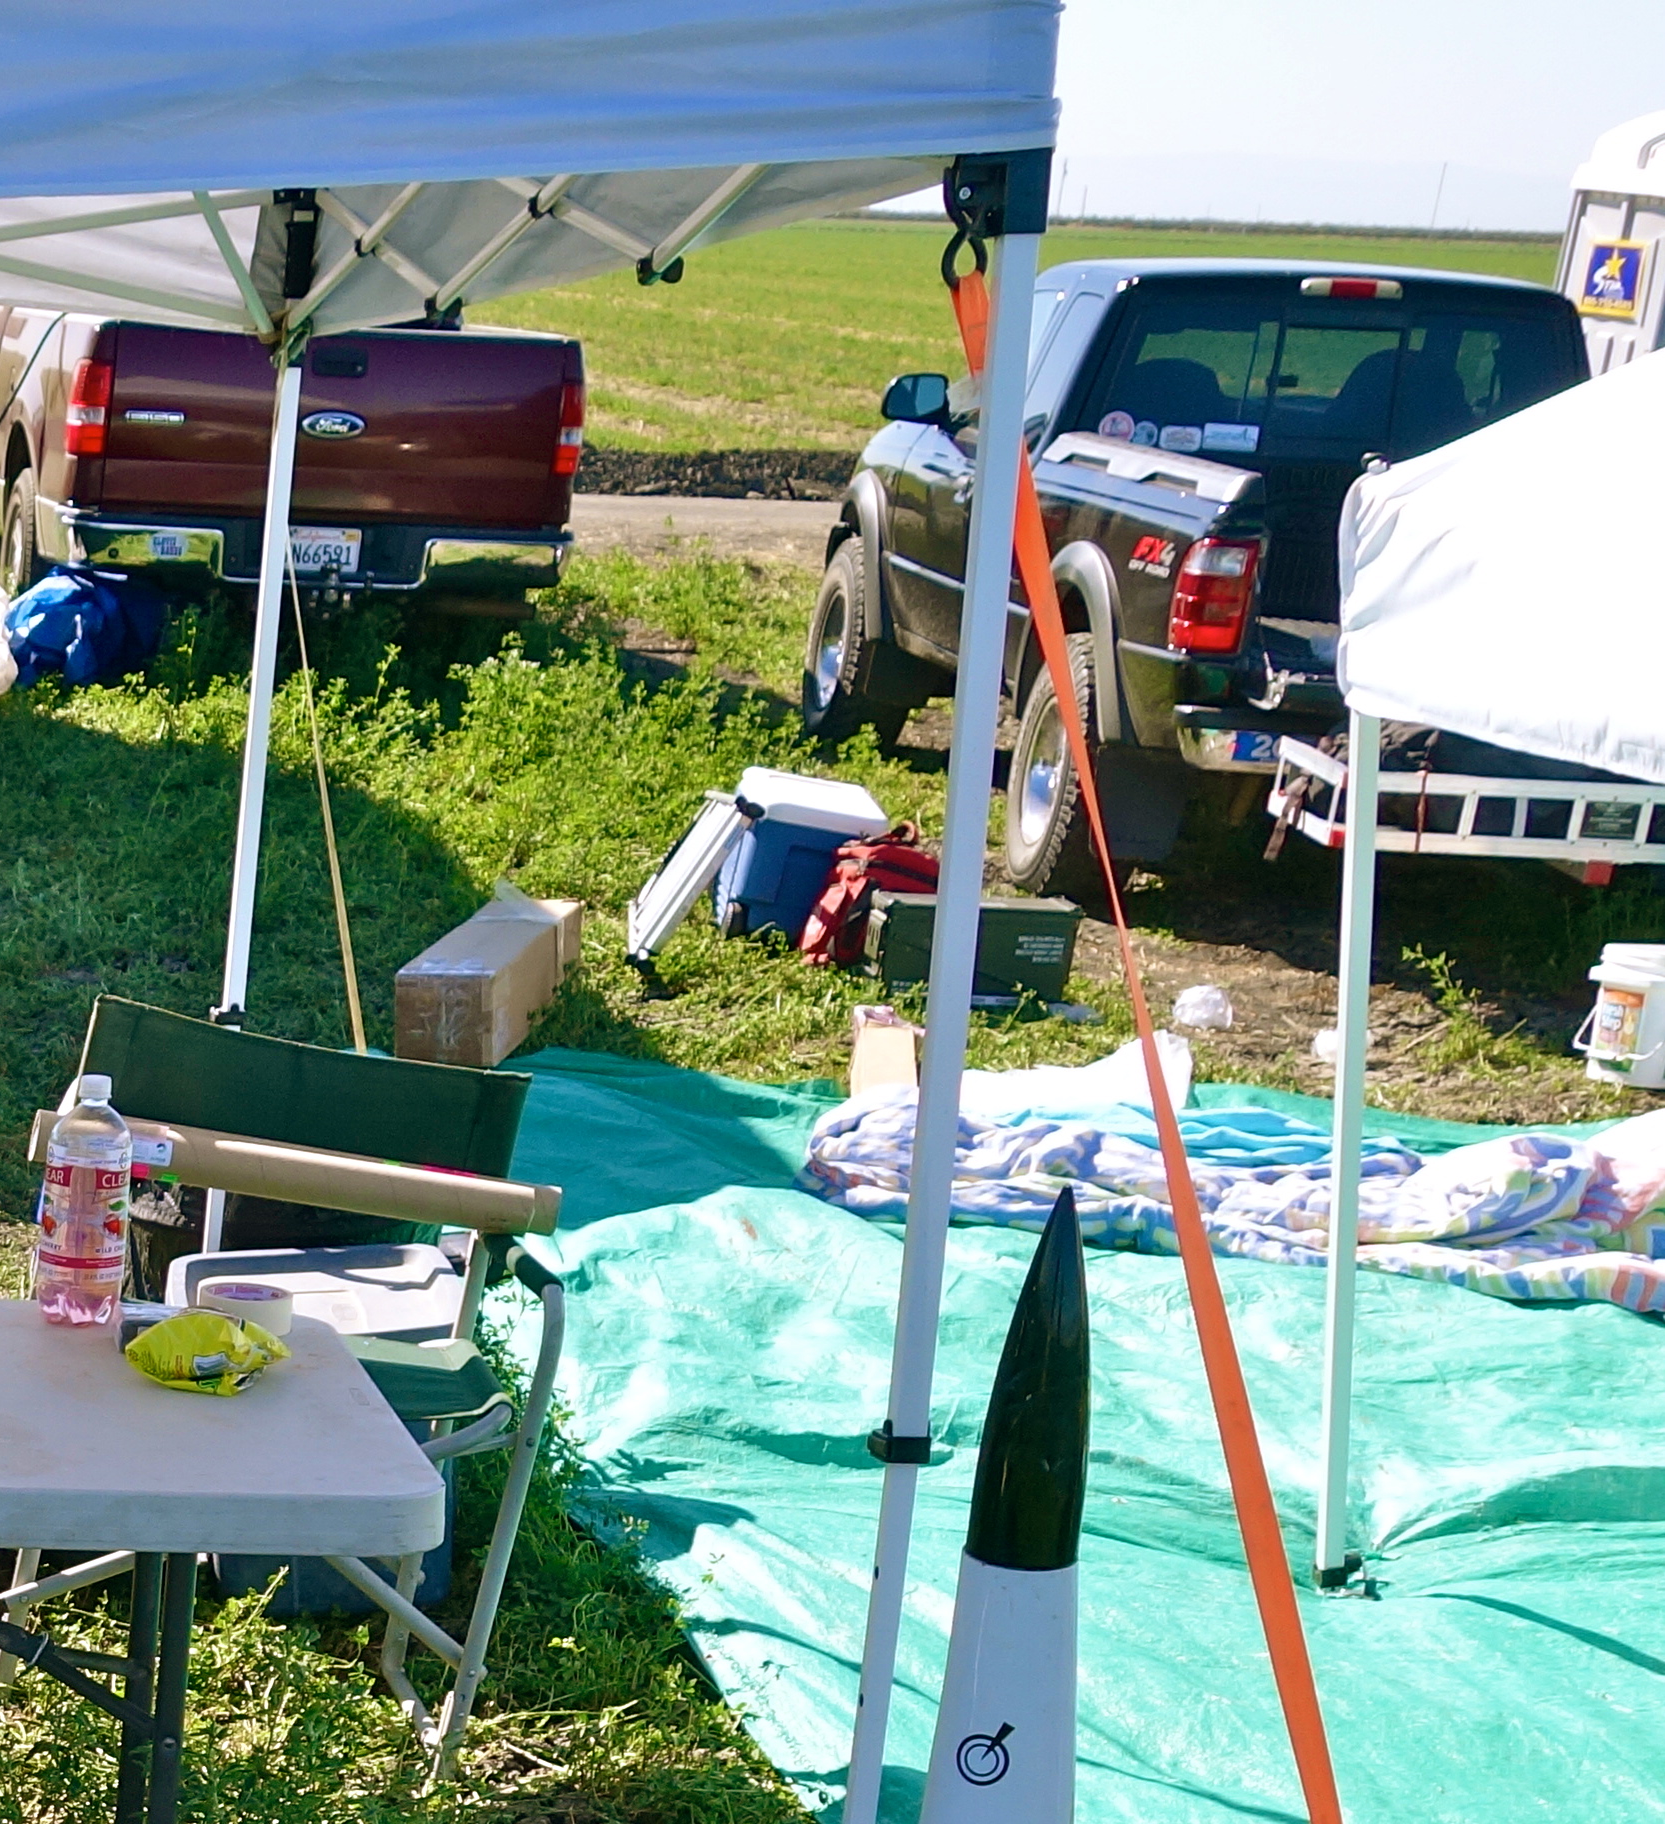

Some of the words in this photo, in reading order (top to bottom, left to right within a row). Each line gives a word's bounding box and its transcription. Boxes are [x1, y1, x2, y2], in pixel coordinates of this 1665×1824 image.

[316, 418, 350, 432] Ford
[291, 543, 352, 565] N66591
[1133, 535, 1176, 566] FX4
[46, 1168, 64, 1184] EAR
